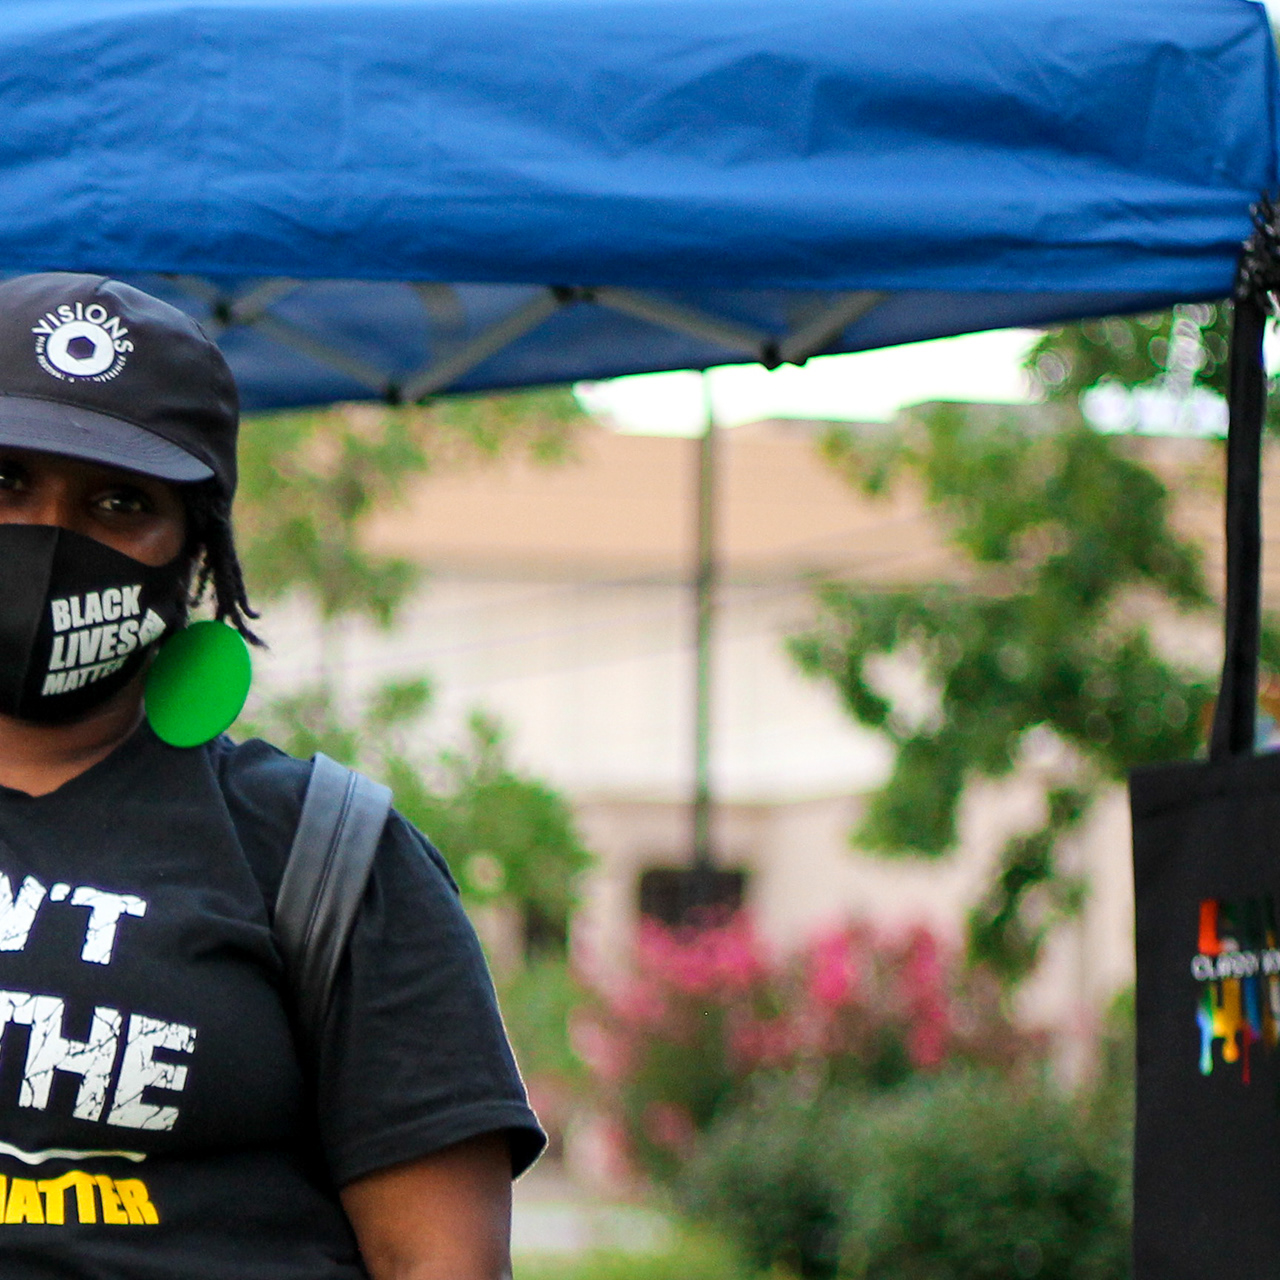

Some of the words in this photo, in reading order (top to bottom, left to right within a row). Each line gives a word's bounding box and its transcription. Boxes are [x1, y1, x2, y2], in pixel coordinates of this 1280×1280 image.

[31, 302, 134, 353] VISIONS
[51, 585, 142, 632] BLACK
[48, 619, 139, 671] LIVES
